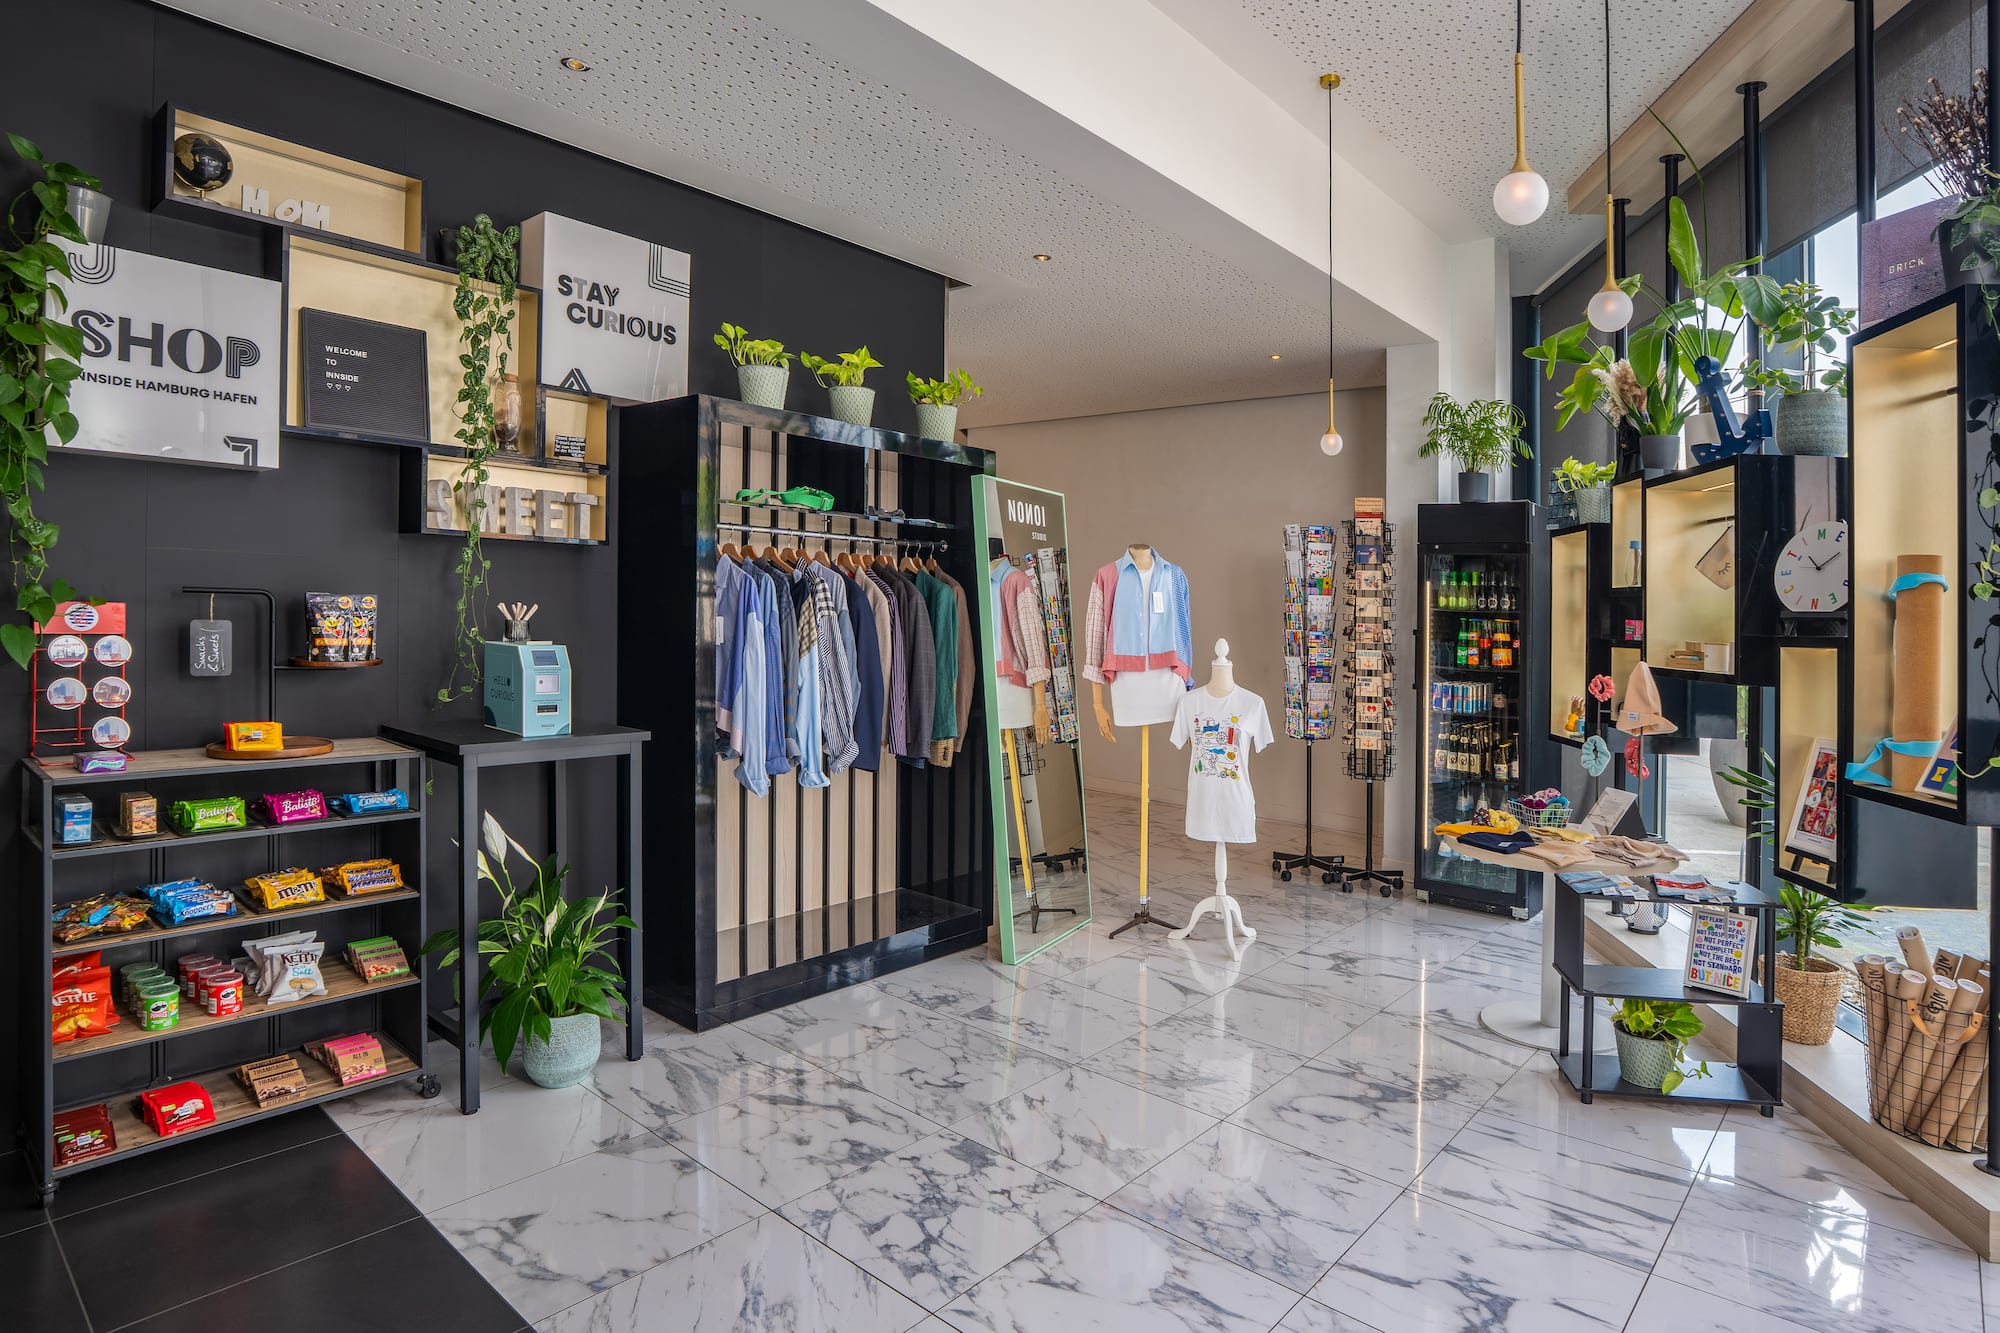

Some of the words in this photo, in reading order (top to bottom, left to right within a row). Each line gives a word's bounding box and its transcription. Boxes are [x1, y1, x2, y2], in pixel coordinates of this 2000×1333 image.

[1888, 257, 1925, 274] BRICK
[557, 274, 620, 307] STAY
[566, 302, 677, 345] CURIOUS
[71, 310, 261, 379] SHOP
[325, 345, 368, 359] WELCOME
[325, 358, 337, 366] TO
[325, 371, 359, 383] INNSIDE
[75, 370, 132, 388] NNSIDE
[135, 379, 210, 399] HAMBURG
[213, 390, 258, 406] HAFEN
[197, 805, 235, 820] Balisto
[282, 797, 318, 814] Balisto
[1704, 936, 1716, 944] NOT
[1717, 939, 1744, 950] PERFECT
[1706, 945, 1734, 955] COMPLETE
[1693, 959, 1706, 967] NOT
[1699, 950, 1711, 958] NOT
[1712, 953, 1723, 962] THE
[1724, 956, 1740, 966] BEST
[292, 967, 313, 976] Salt
[1690, 967, 1712, 983] BUT
[1713, 971, 1741, 989] NICE
